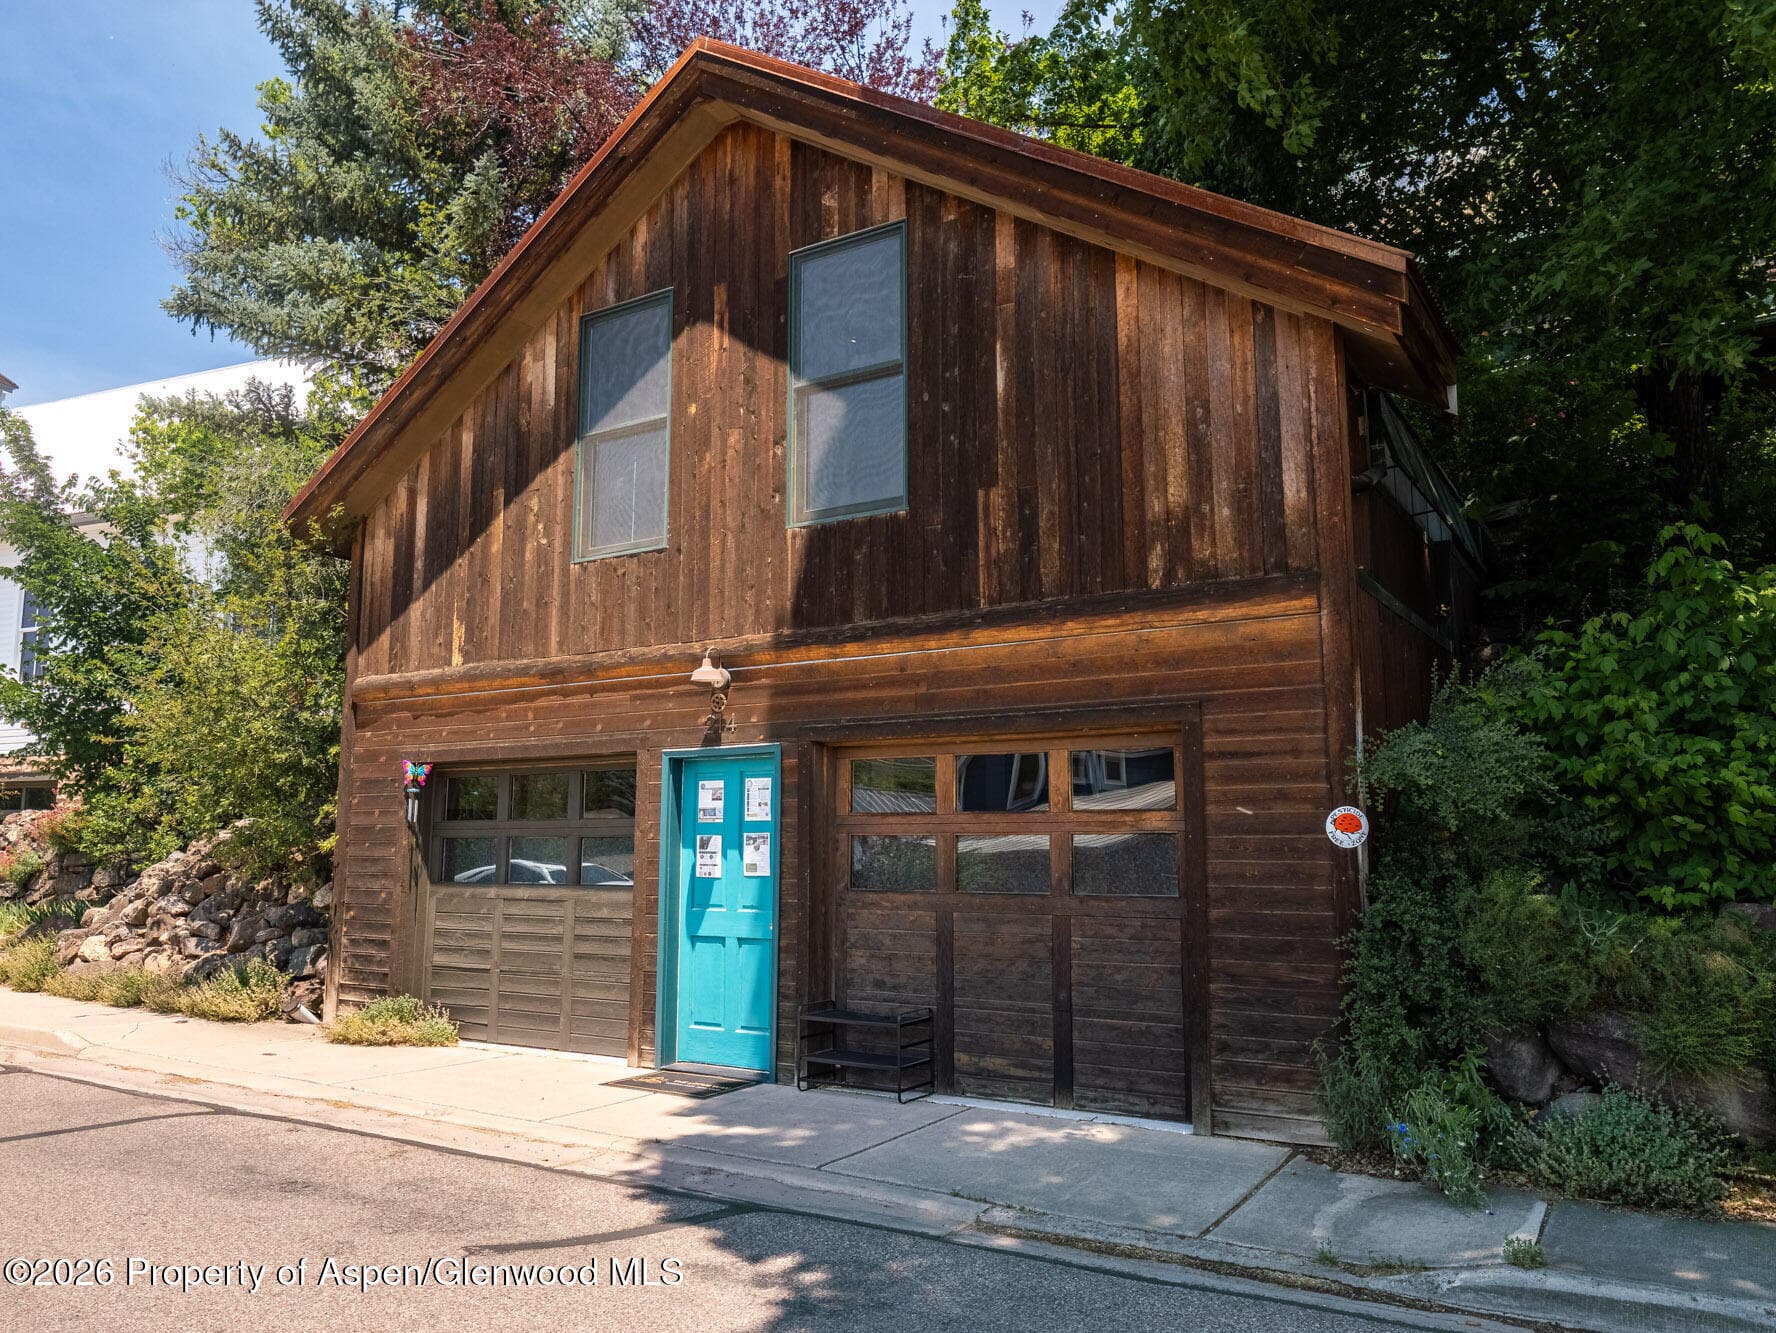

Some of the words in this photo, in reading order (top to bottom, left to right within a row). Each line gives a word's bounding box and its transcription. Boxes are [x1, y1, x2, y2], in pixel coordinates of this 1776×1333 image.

[1330, 807, 1364, 820] PESTICIDE
[1328, 831, 1345, 846] FREE
[1351, 831, 1367, 846] ZONE
